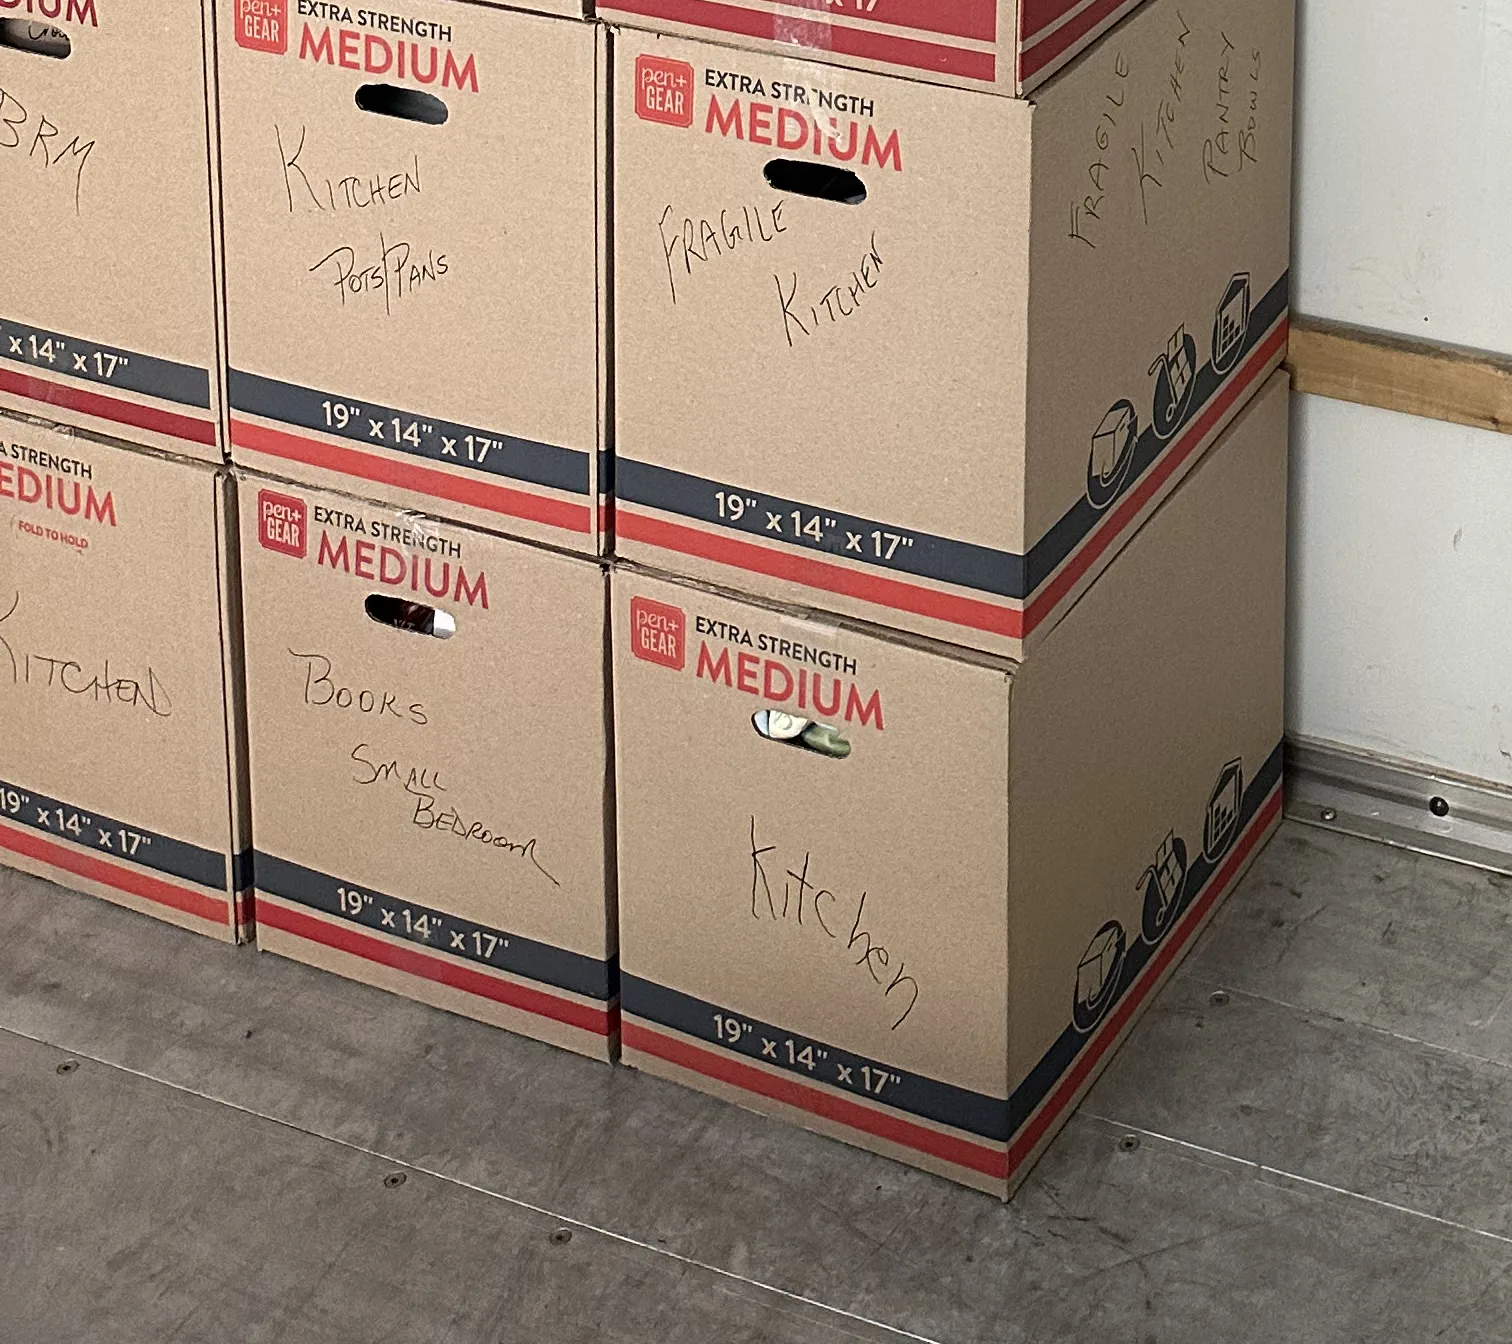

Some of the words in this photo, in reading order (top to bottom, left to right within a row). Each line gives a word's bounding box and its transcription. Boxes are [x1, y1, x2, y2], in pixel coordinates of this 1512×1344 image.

[244, 15, 279, 44] GEAR
[357, 9, 452, 43] STRENGTH
[299, 28, 479, 93] MEDIUM
[705, 68, 766, 97] EXTRA
[771, 81, 875, 118] STRNGTH
[645, 86, 685, 115] GEAR
[705, 94, 903, 172] MEDIUM
[1131, 9, 1191, 225] KITCHEN
[275, 124, 421, 212] KITCHEN
[1068, 52, 1130, 248] FRAGILE
[659, 200, 788, 304] FRAGILE
[773, 230, 885, 347] KITCHEN
[0, 461, 116, 526] EDIUM
[11, 443, 92, 480] STRENGTH
[18, 520, 44, 537] FOLD
[45, 528, 59, 541] TO
[60, 533, 88, 548] HOLD
[266, 516, 300, 547] GEAR
[314, 505, 366, 537] EXTRA
[371, 520, 461, 559] STRENGTH
[714, 490, 757, 520] 19"
[765, 513, 782, 533] x
[792, 511, 836, 541] 14"
[846, 532, 862, 552] x
[870, 529, 914, 560] 17"
[318, 529, 489, 609] MEDIUM
[641, 628, 677, 658] GEAR
[695, 615, 753, 648] EXTRA
[757, 633, 857, 675] STRENGTH
[288, 648, 429, 726] BOOKS
[696, 641, 884, 730] MEDIUM
[337, 887, 374, 915] 19"
[381, 909, 397, 929] x
[402, 908, 443, 939] 14"
[450, 930, 466, 950] x
[472, 929, 509, 959] 17"
